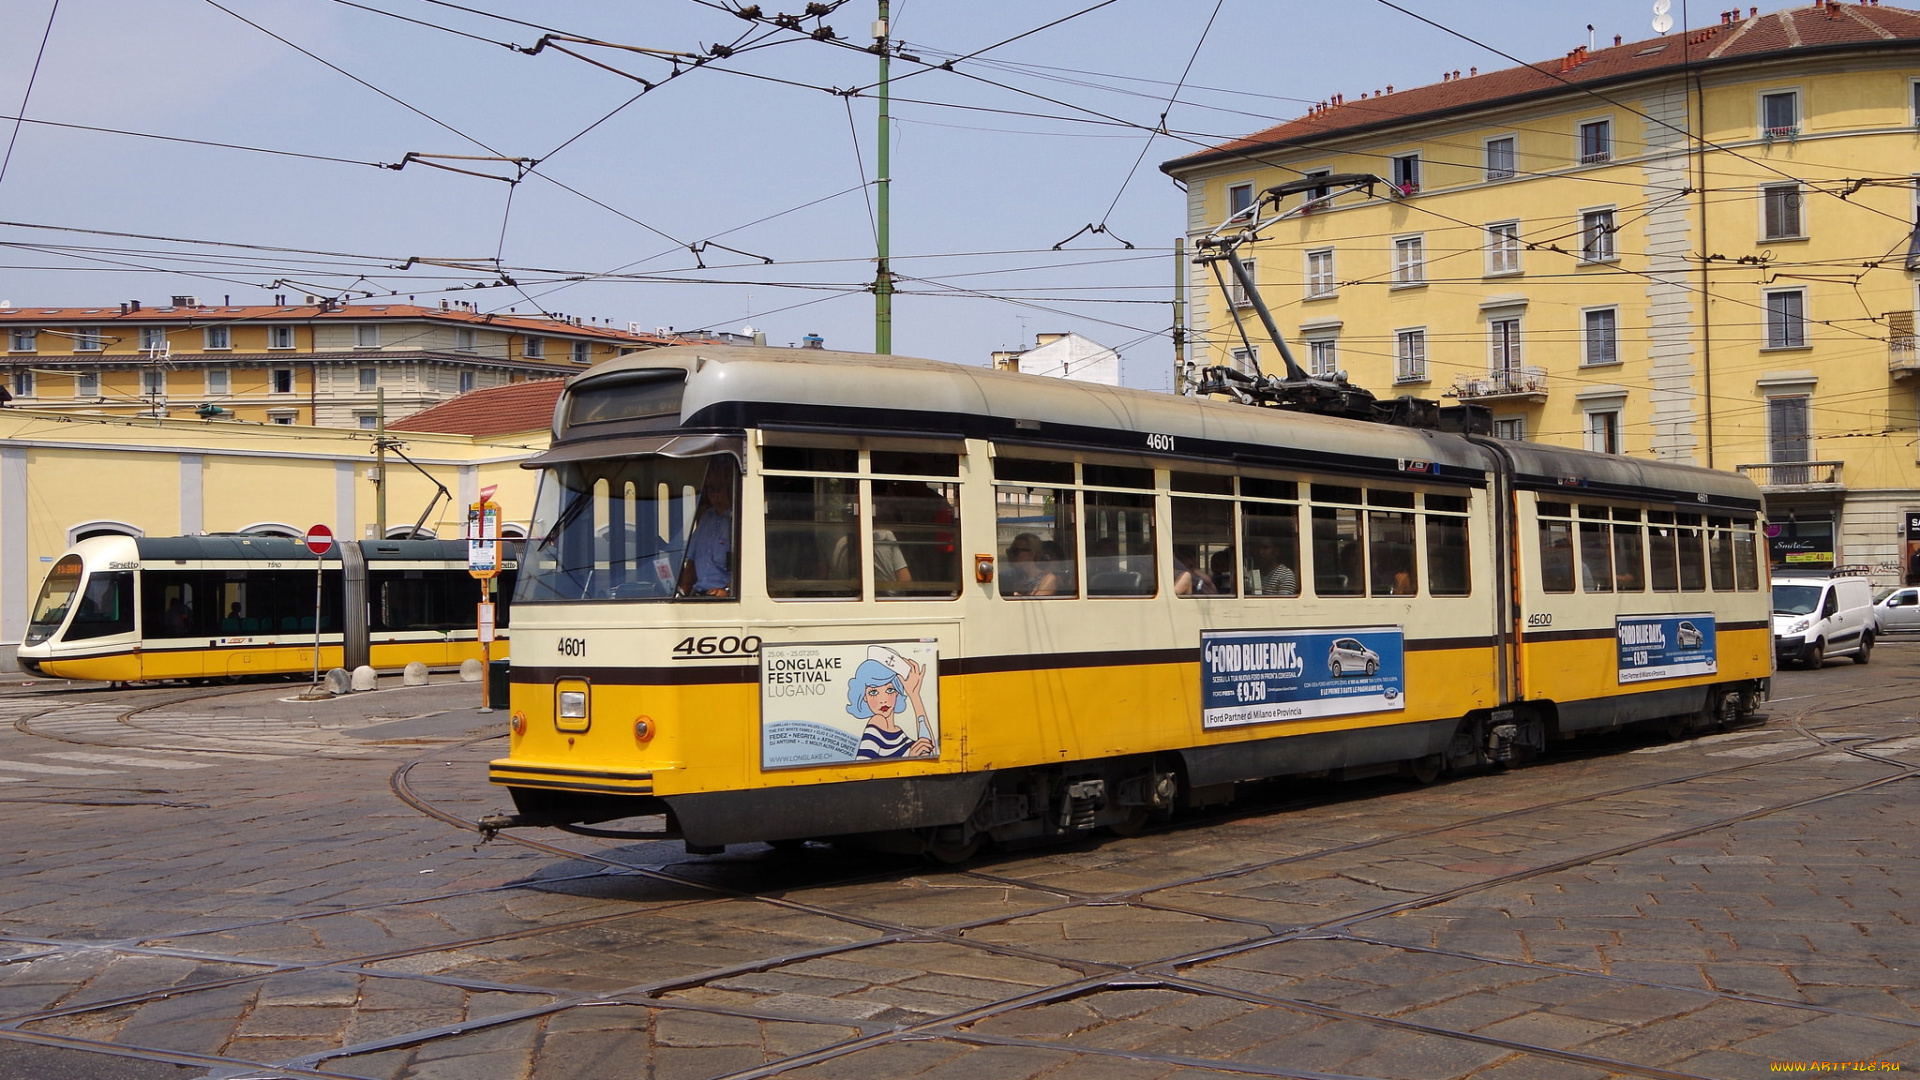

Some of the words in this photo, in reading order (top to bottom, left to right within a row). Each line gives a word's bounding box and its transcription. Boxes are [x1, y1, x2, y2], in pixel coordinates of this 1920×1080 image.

[1147, 434, 1175, 451] 4601
[1775, 541, 1802, 549] Smile
[1528, 614, 1552, 624] 4600
[558, 637, 586, 657] 4601
[673, 636, 762, 654] 4600
[1242, 643, 1269, 670] BLUE
[768, 658, 841, 671] LONGLAKE
[768, 671, 831, 684] FESTIVAL
[768, 684, 825, 697] LUGANO
[1243, 681, 1266, 701] 9.750
[1210, 714, 1224, 723] Ford
[1225, 713, 1246, 722] Partner
[1253, 710, 1272, 718] Milano
[1277, 708, 1302, 716] Provincia
[821, 737, 839, 746] AFRICA
[841, 743, 855, 752] UNITE
